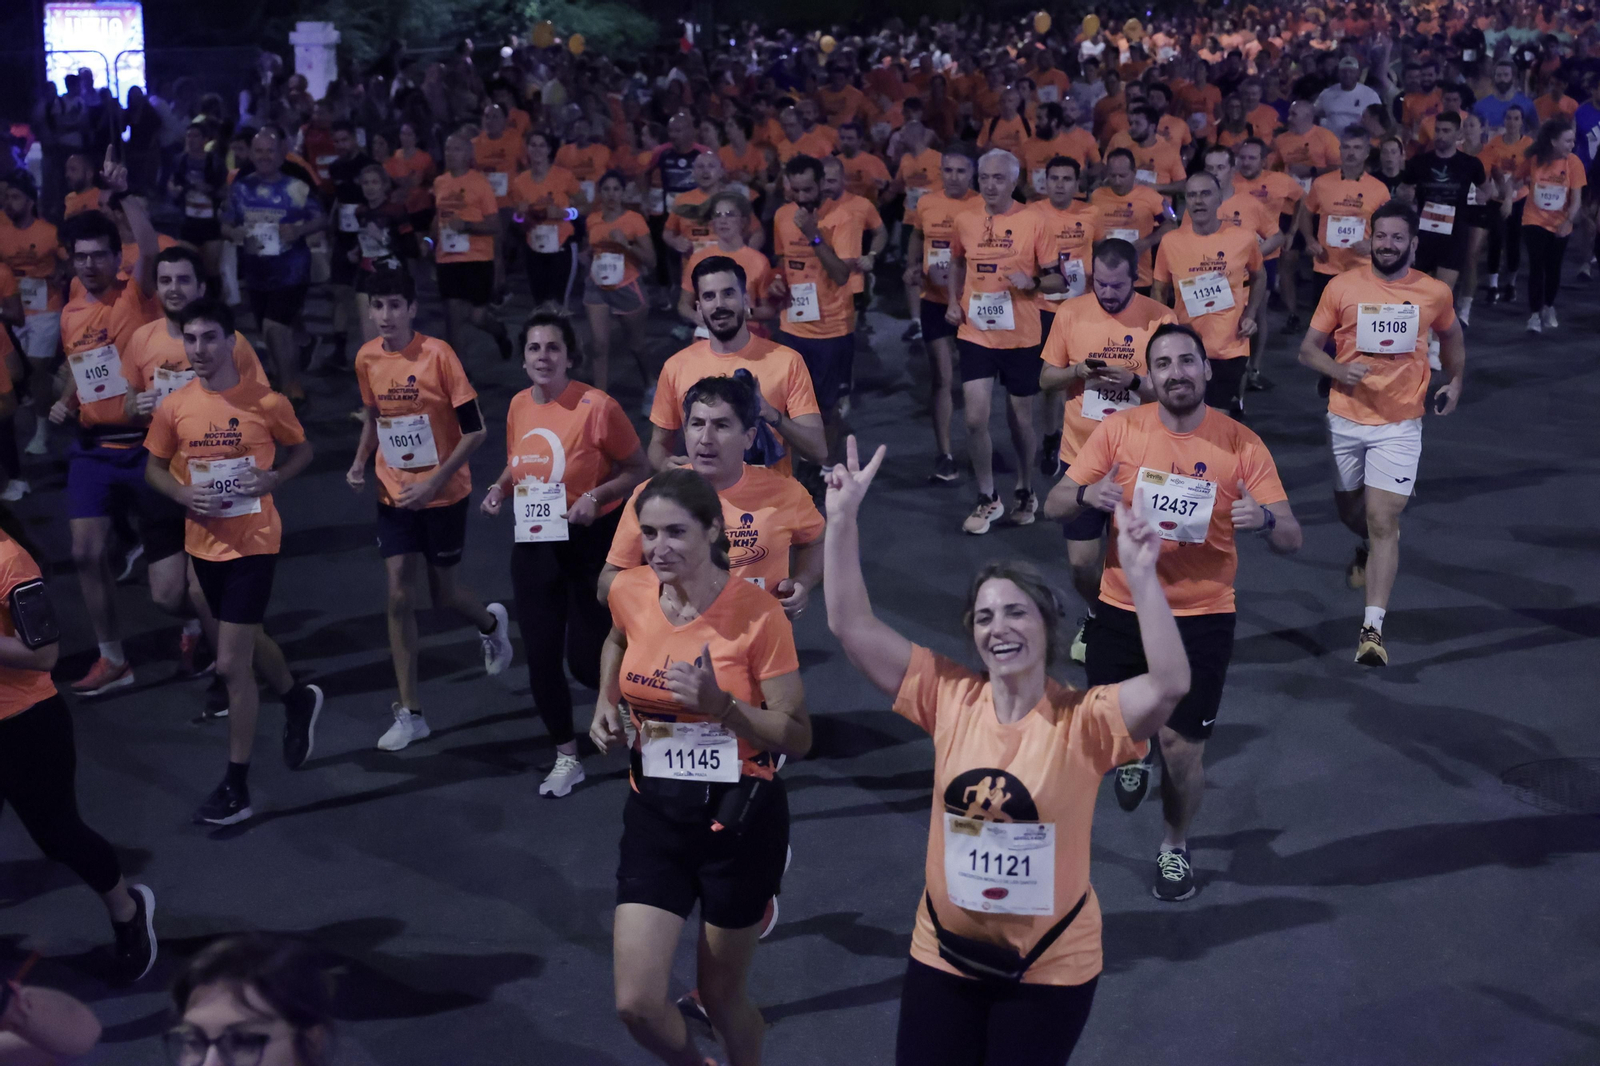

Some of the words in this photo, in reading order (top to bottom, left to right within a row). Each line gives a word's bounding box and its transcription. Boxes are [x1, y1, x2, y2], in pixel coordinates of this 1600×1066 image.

[1337, 226, 1356, 235] 6451
[1193, 285, 1222, 300] 11314
[977, 305, 1005, 316] 21698
[1371, 320, 1407, 334] 15108
[85, 364, 109, 380] 4105
[1096, 387, 1131, 402] 13244
[389, 433, 422, 447] 16011
[525, 503, 551, 518] 3728
[1152, 493, 1198, 517] 12437
[664, 748, 720, 770] 11145
[969, 849, 1030, 877] 11121
